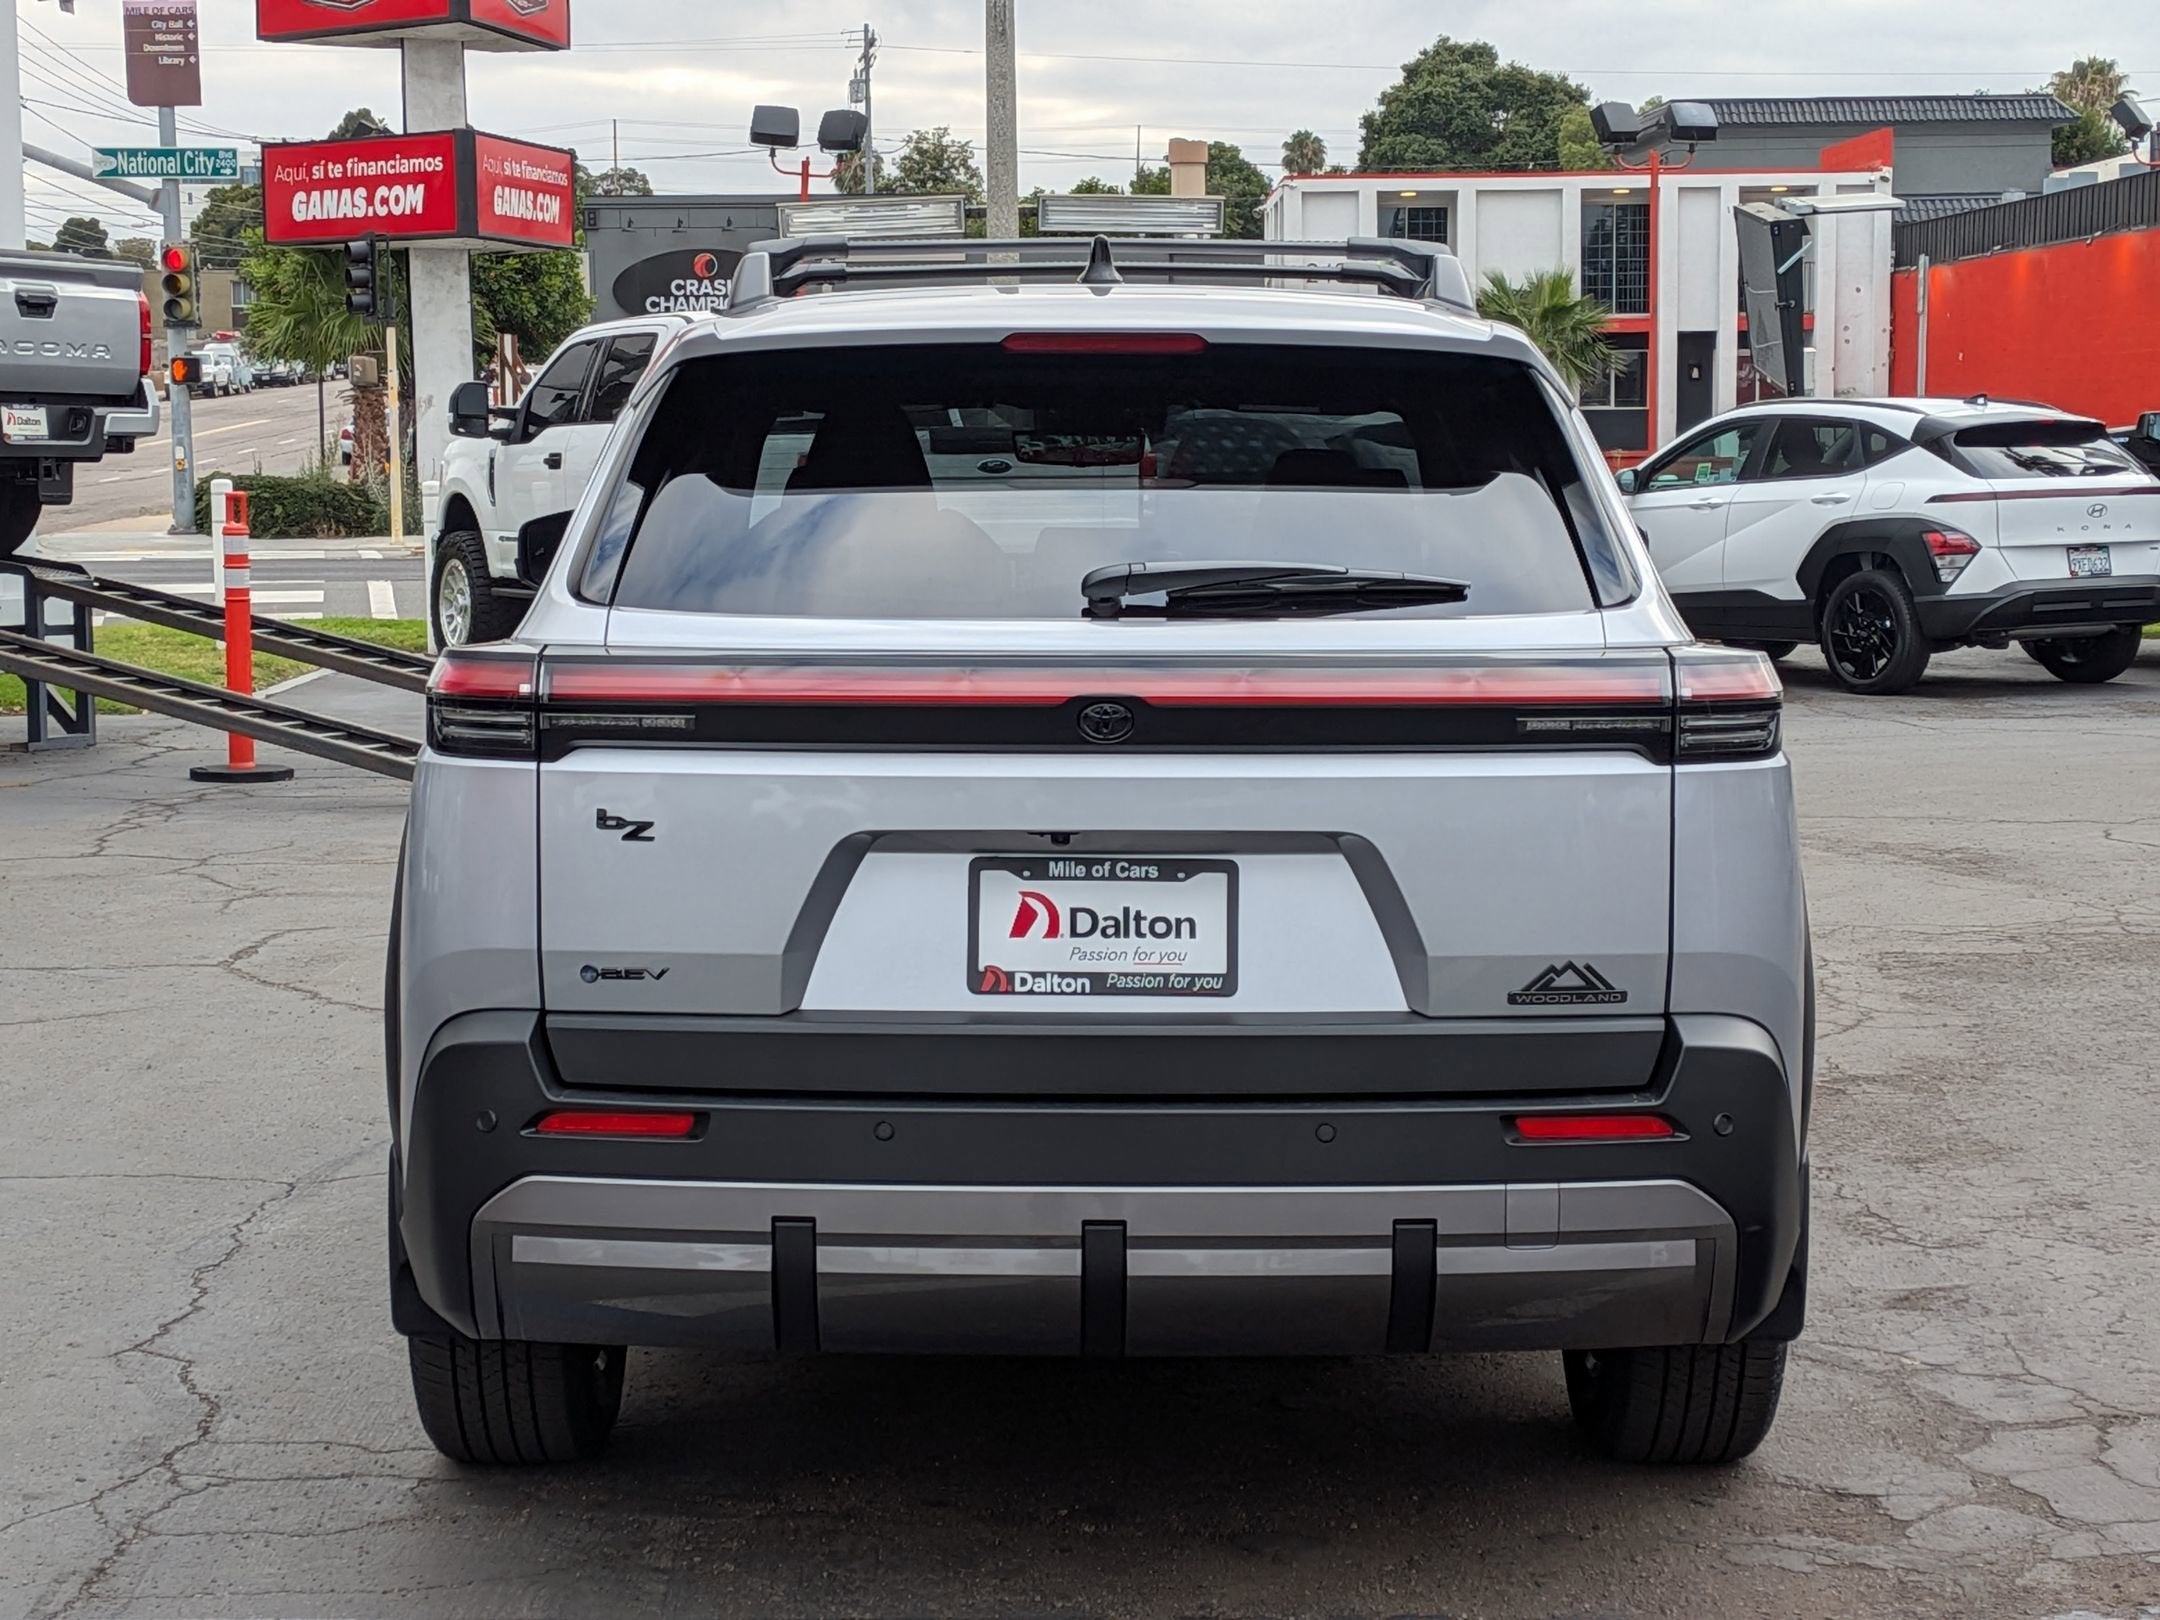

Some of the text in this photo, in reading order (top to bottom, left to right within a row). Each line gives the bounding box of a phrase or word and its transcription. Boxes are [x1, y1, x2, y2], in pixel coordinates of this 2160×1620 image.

[125, 6, 194, 16] MILE OF CARS
[117, 151, 215, 176] National City
[274, 154, 443, 186] Aquí, sí te financiamos
[292, 183, 425, 222] GANAS.COM
[493, 185, 560, 225] GANAS.COM
[2057, 523, 2132, 532] KONA
[1048, 861, 1159, 879] Mile of Cars
[1069, 906, 1197, 939] Dalton
[1069, 946, 1188, 964] Passion for you
[1014, 972, 1091, 993] Dalton
[1106, 973, 1223, 991] Passion for you
[1516, 993, 1621, 1003] WOODLAND
